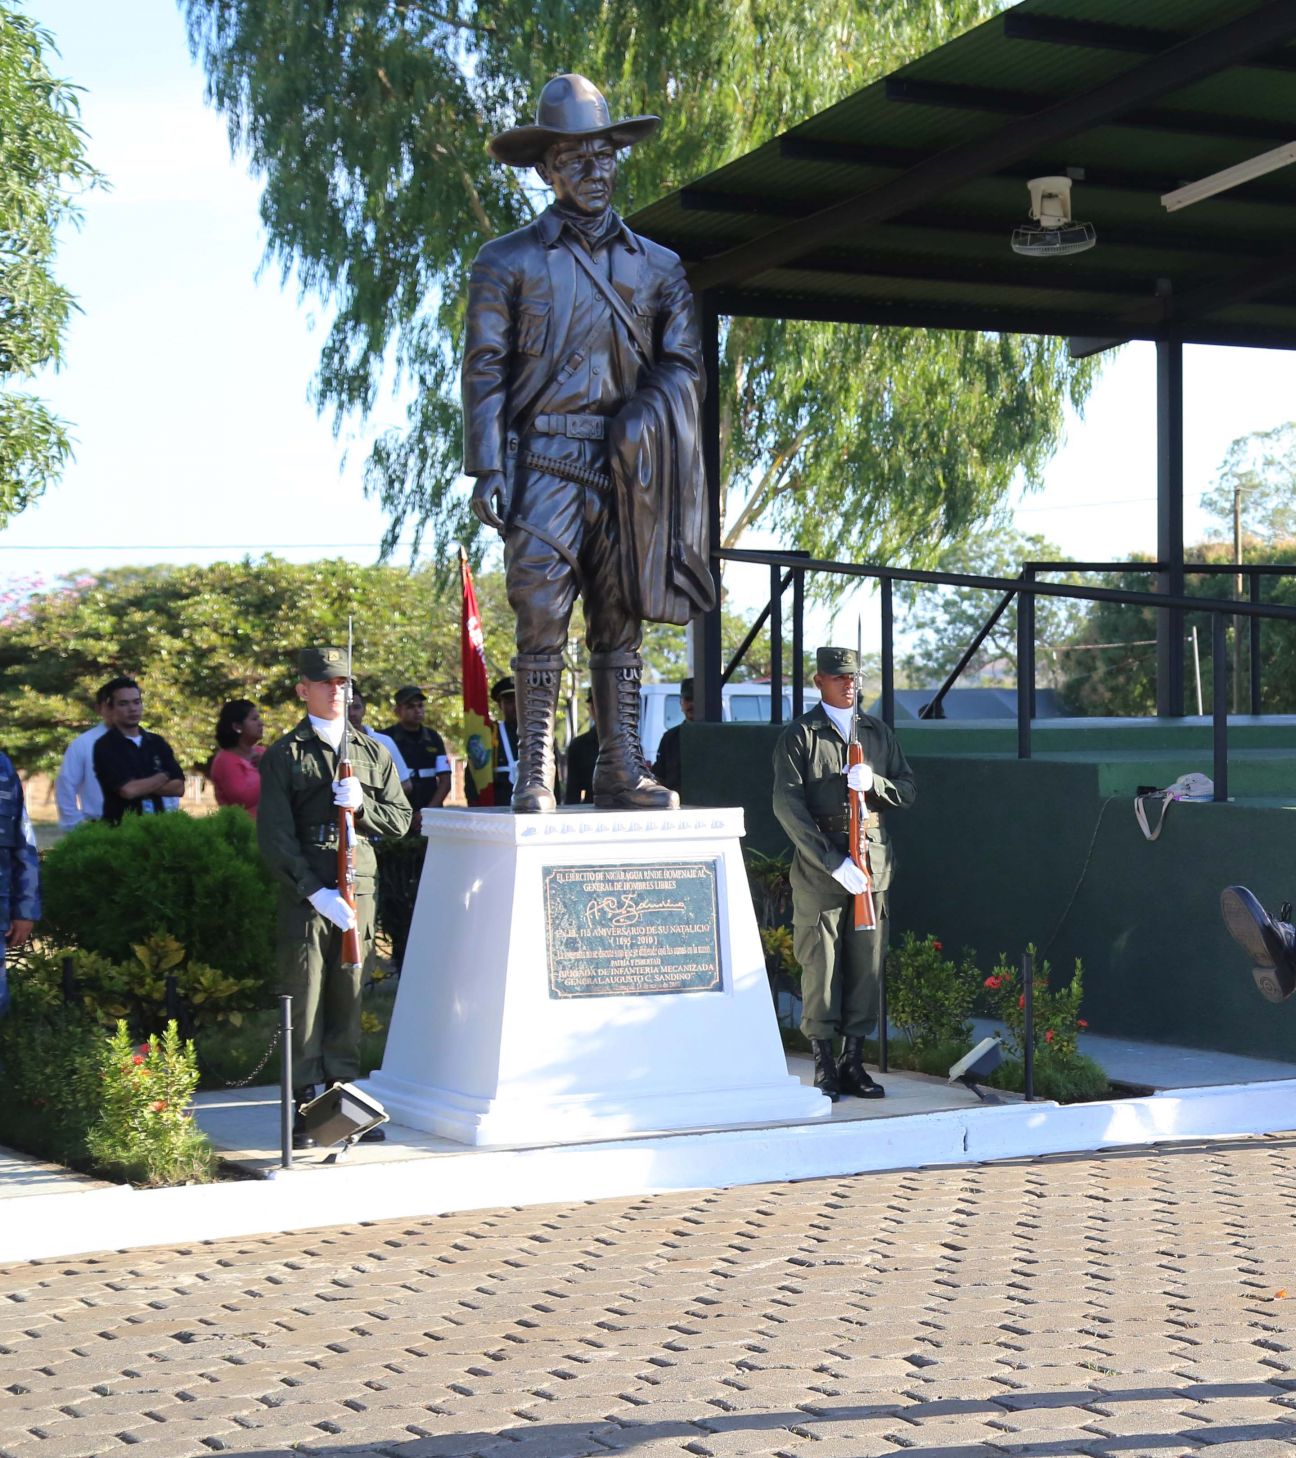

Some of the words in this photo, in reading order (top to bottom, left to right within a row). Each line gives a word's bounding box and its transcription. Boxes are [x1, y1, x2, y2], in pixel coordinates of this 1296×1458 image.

[595, 872, 604, 881] DE
[605, 870, 643, 881] NICARAGUA
[583, 883, 613, 892] GENERAL
[614, 882, 622, 891] DE
[623, 881, 654, 890] HOMBRES
[655, 880, 677, 890] LIBRES
[592, 926, 645, 936] ANIVERSARIO
[646, 926, 656, 934] DE
[657, 925, 669, 934] SU
[670, 924, 710, 934] NATALICIO
[598, 967, 609, 975] DE
[660, 963, 714, 973] MECANIZADA
[604, 975, 643, 984] AUGUSTO
